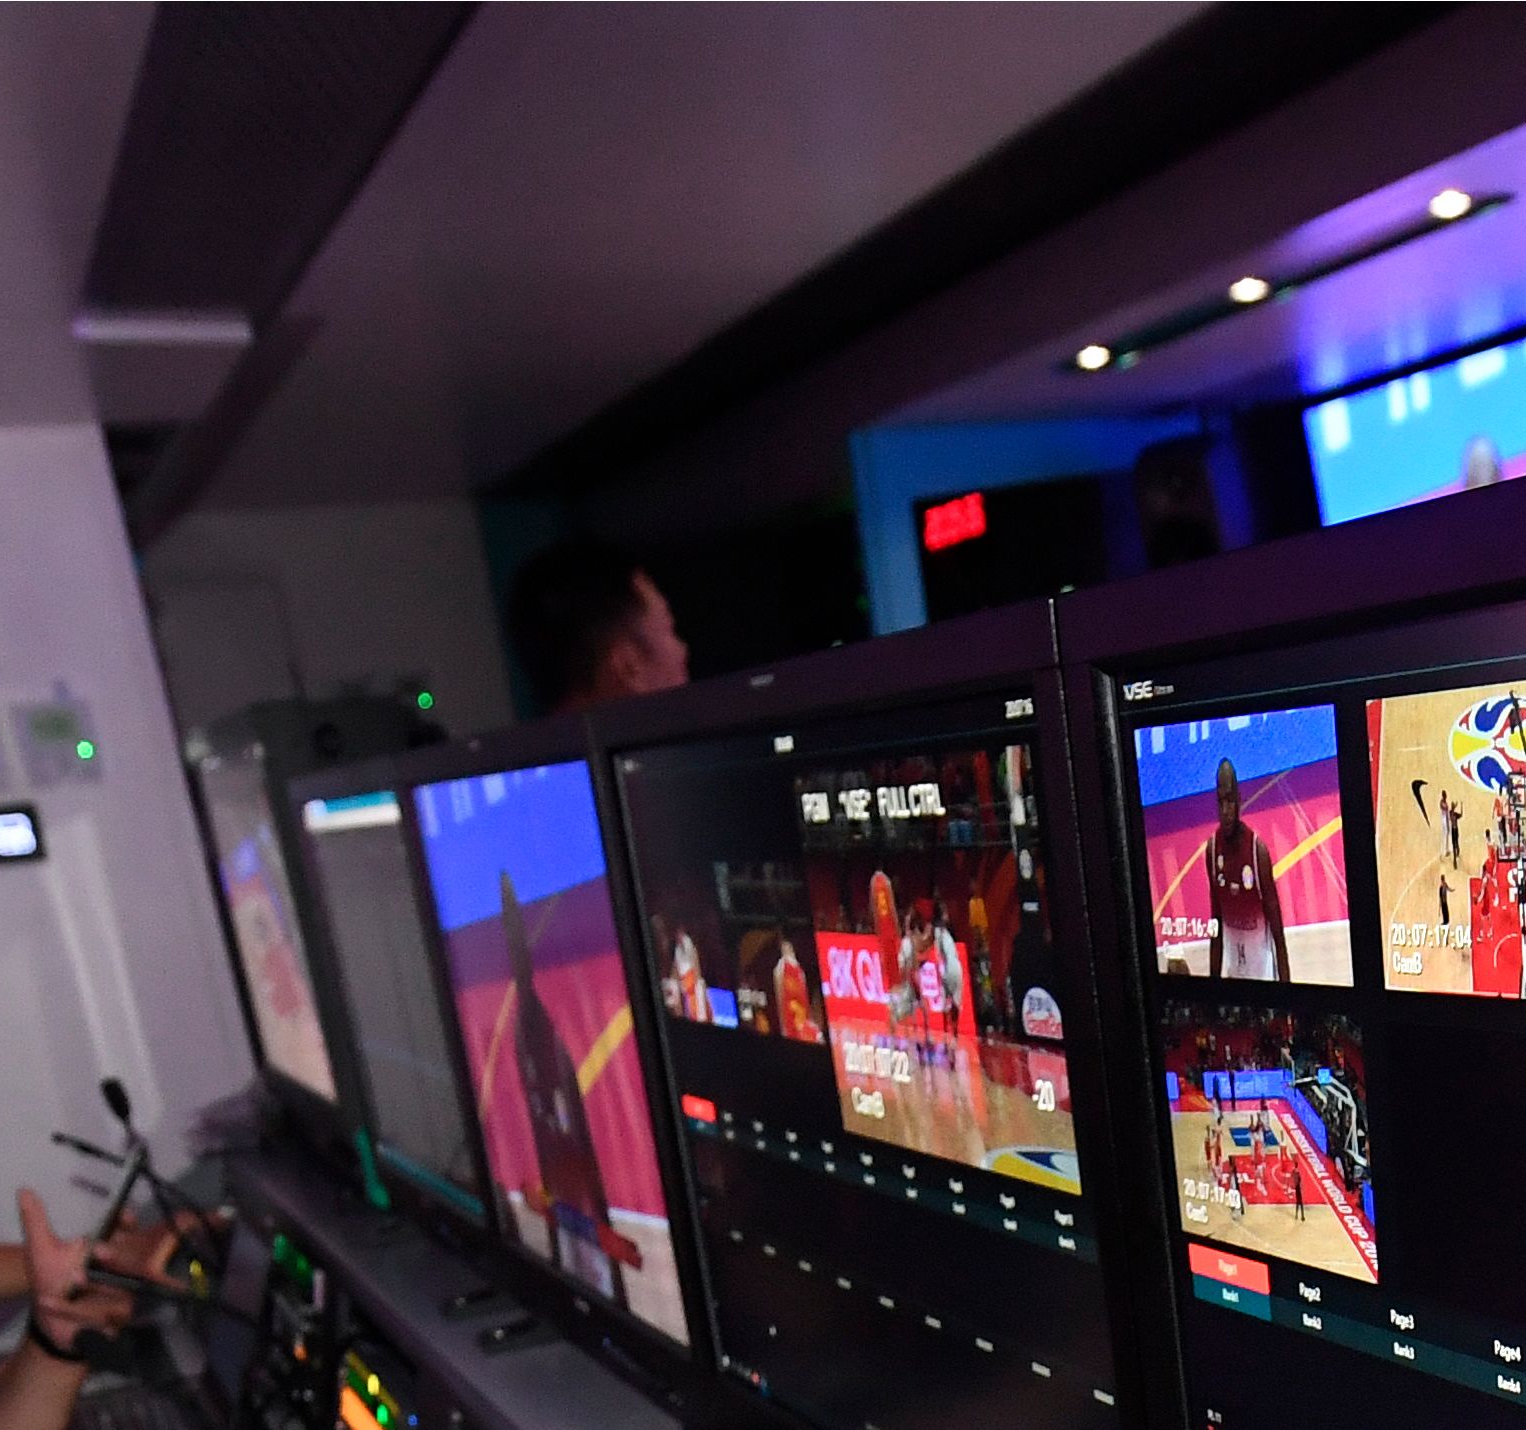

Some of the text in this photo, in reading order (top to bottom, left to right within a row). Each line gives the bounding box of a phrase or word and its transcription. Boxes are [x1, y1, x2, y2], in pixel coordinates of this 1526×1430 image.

[1391, 921, 1473, 948] 20:07:17:04
[1390, 1309, 1414, 1330] Page3
[1494, 1340, 1521, 1362] Page4
